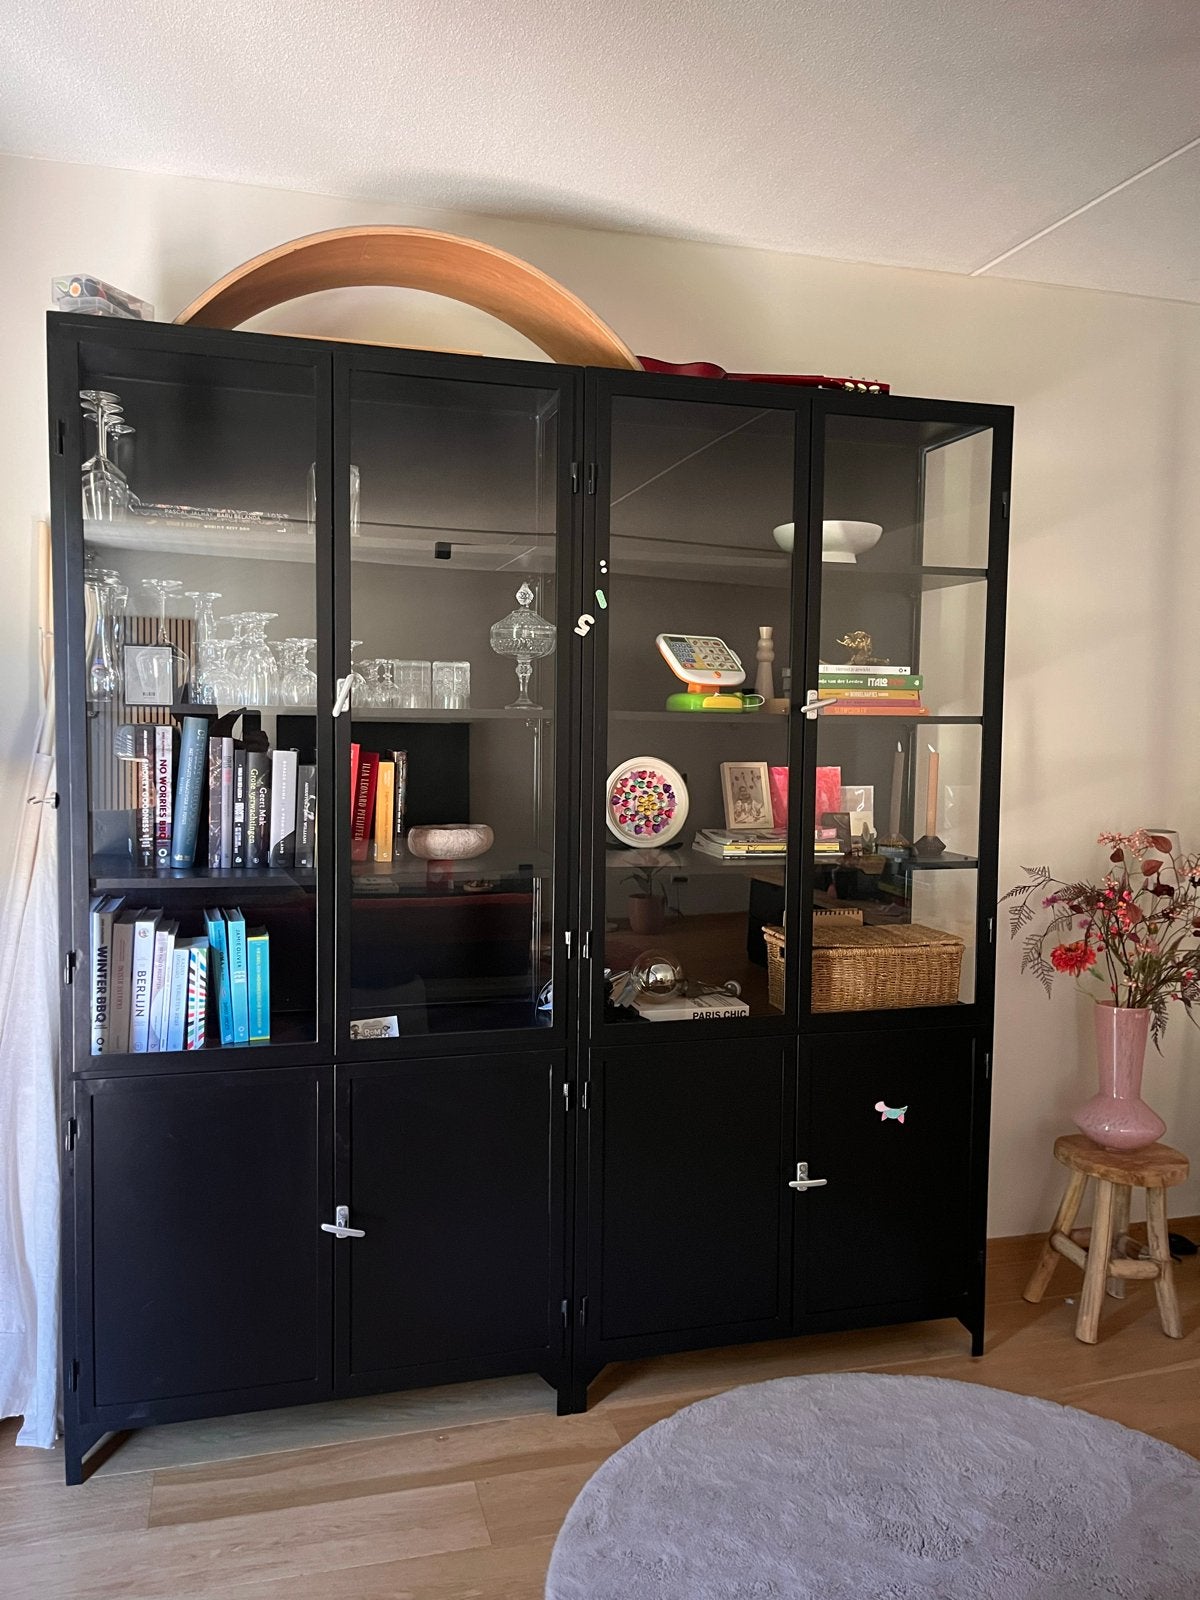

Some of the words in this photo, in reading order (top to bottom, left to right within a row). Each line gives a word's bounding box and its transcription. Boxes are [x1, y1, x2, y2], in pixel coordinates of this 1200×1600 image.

[159, 759, 167, 774] NO
[250, 768, 259, 790] Grote
[159, 776, 167, 818] WORRIES
[259, 787, 268, 808] Geert
[359, 779, 370, 806] LEONARD
[141, 790, 149, 833] GOODNESS
[247, 791, 258, 845] verwachtingen
[258, 809, 267, 826] Mak
[159, 820, 167, 840] BBQ
[96, 945, 108, 995] WINTER
[135, 970, 147, 1017] BERLIJN
[95, 996, 107, 1023] BBQ
[692, 1011, 721, 1020] PARIS
[723, 1009, 747, 1018] CHIC
